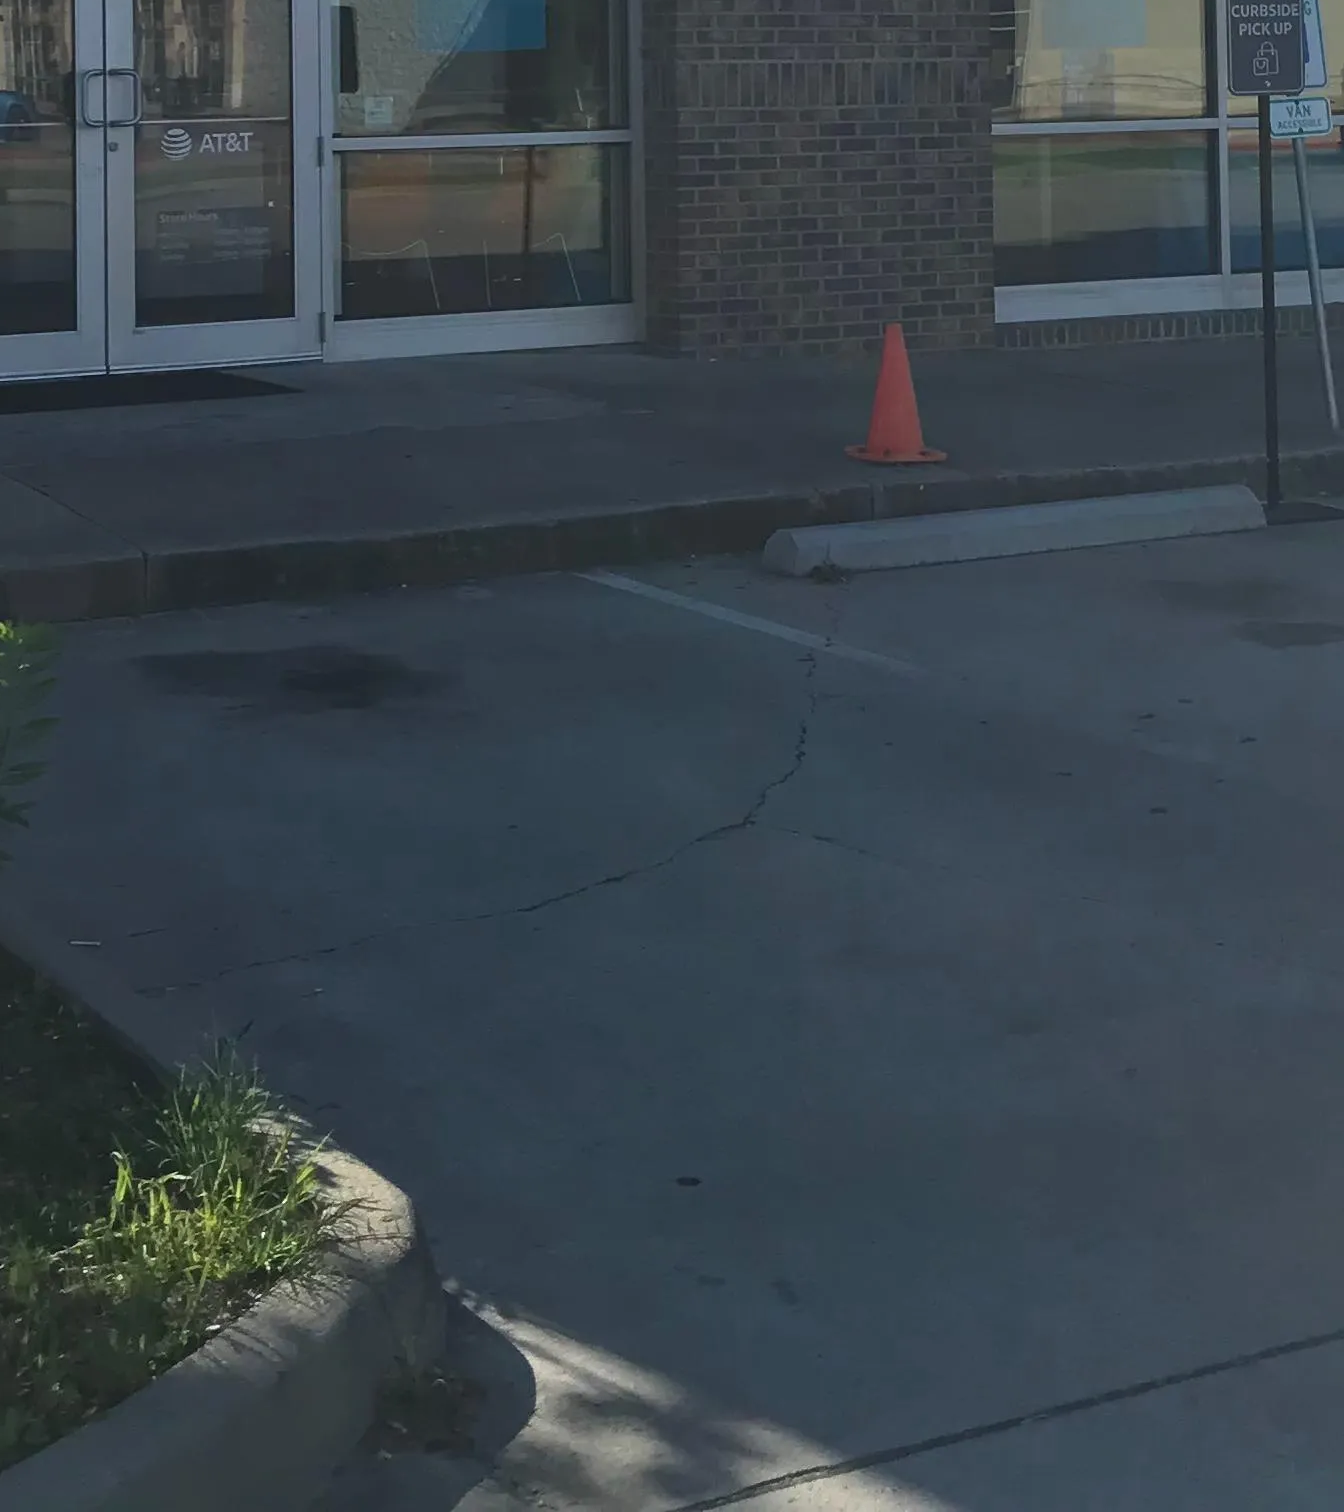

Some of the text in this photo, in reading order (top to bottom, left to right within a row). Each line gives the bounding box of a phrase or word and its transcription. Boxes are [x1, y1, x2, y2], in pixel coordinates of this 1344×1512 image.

[1231, 3, 1300, 18] CURBSIDE
[1239, 21, 1293, 36] PICK UP
[1286, 105, 1312, 118] VAN
[198, 131, 254, 155] AT&T
